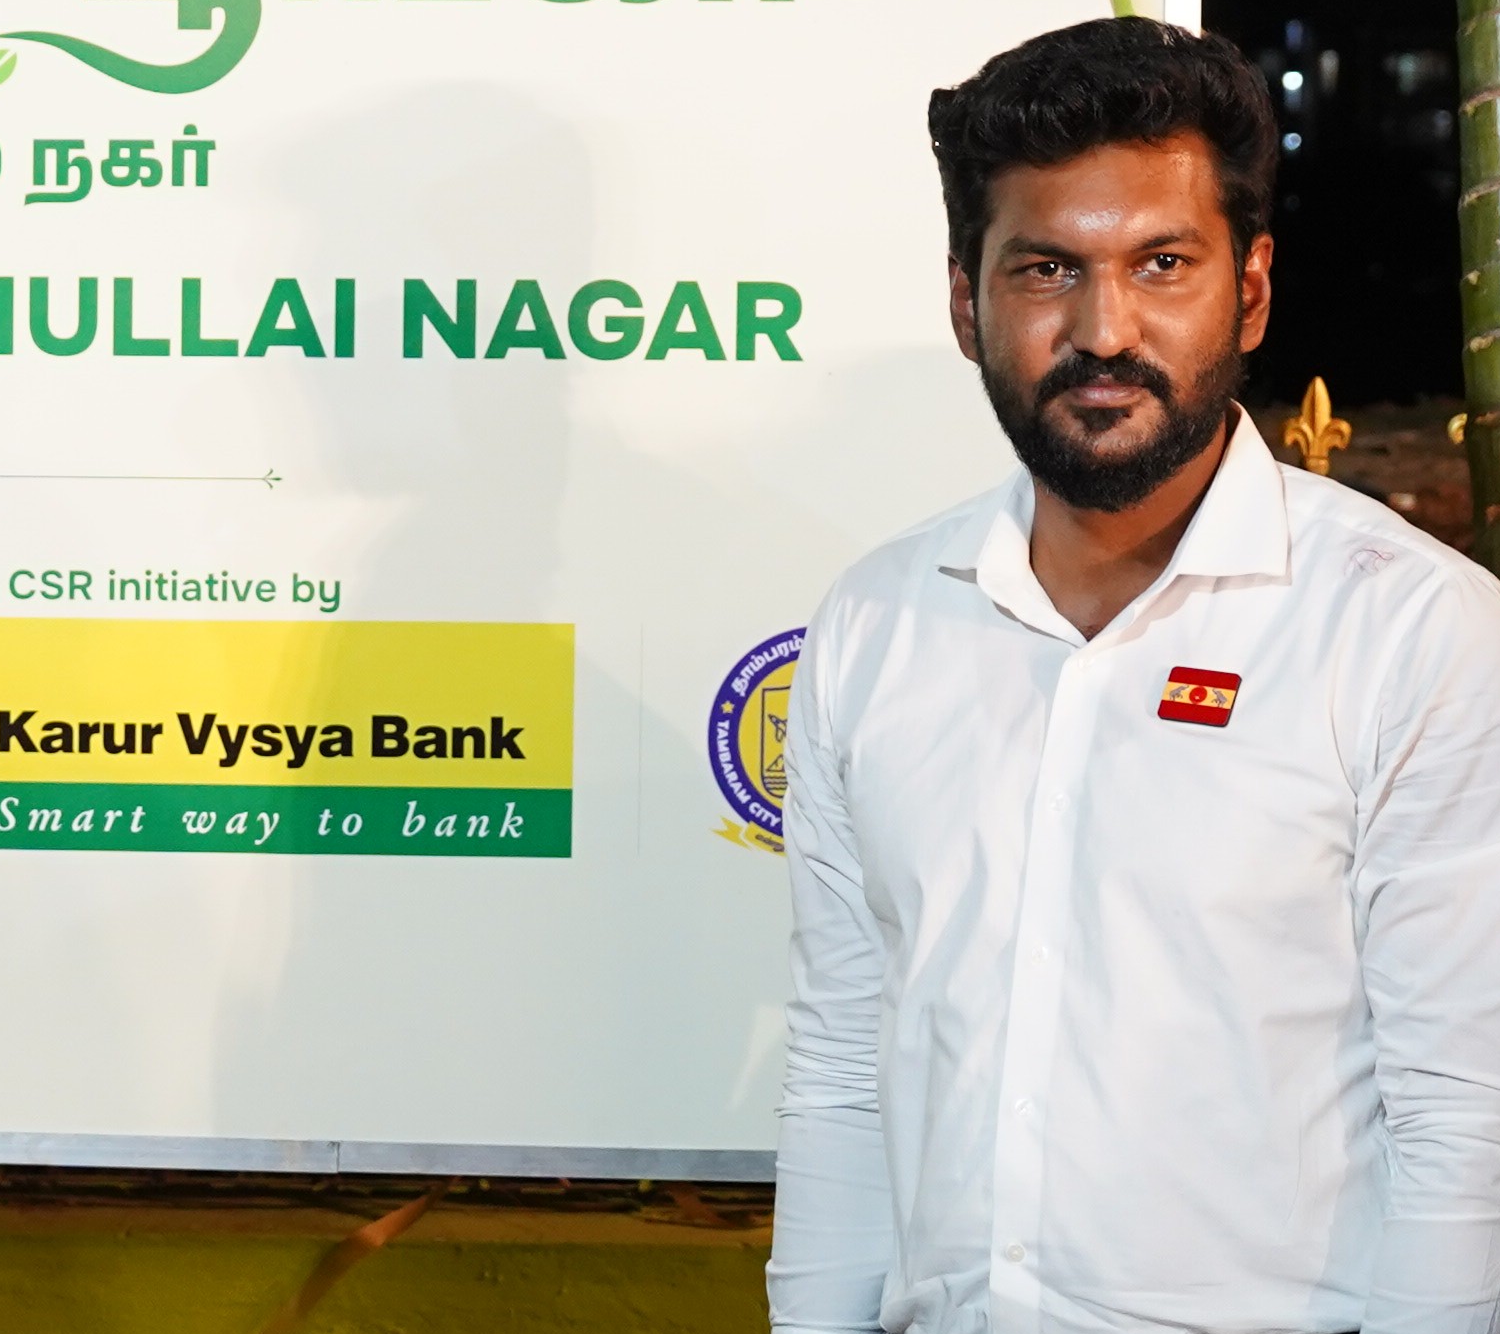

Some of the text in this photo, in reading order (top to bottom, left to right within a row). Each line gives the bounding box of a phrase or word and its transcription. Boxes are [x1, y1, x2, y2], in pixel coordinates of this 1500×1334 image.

[24, 124, 217, 206] நகர்
[404, 280, 802, 363] NAGAR
[9, 571, 94, 601] CSR
[109, 571, 277, 603] initiative
[292, 574, 342, 614] by
[178, 713, 354, 769] Vysya
[371, 715, 526, 761] Bank
[716, 719, 751, 804] TAMBARAM
[748, 800, 782, 830] CITY
[182, 810, 281, 846] way
[319, 810, 364, 837] to
[402, 801, 525, 839] bank
